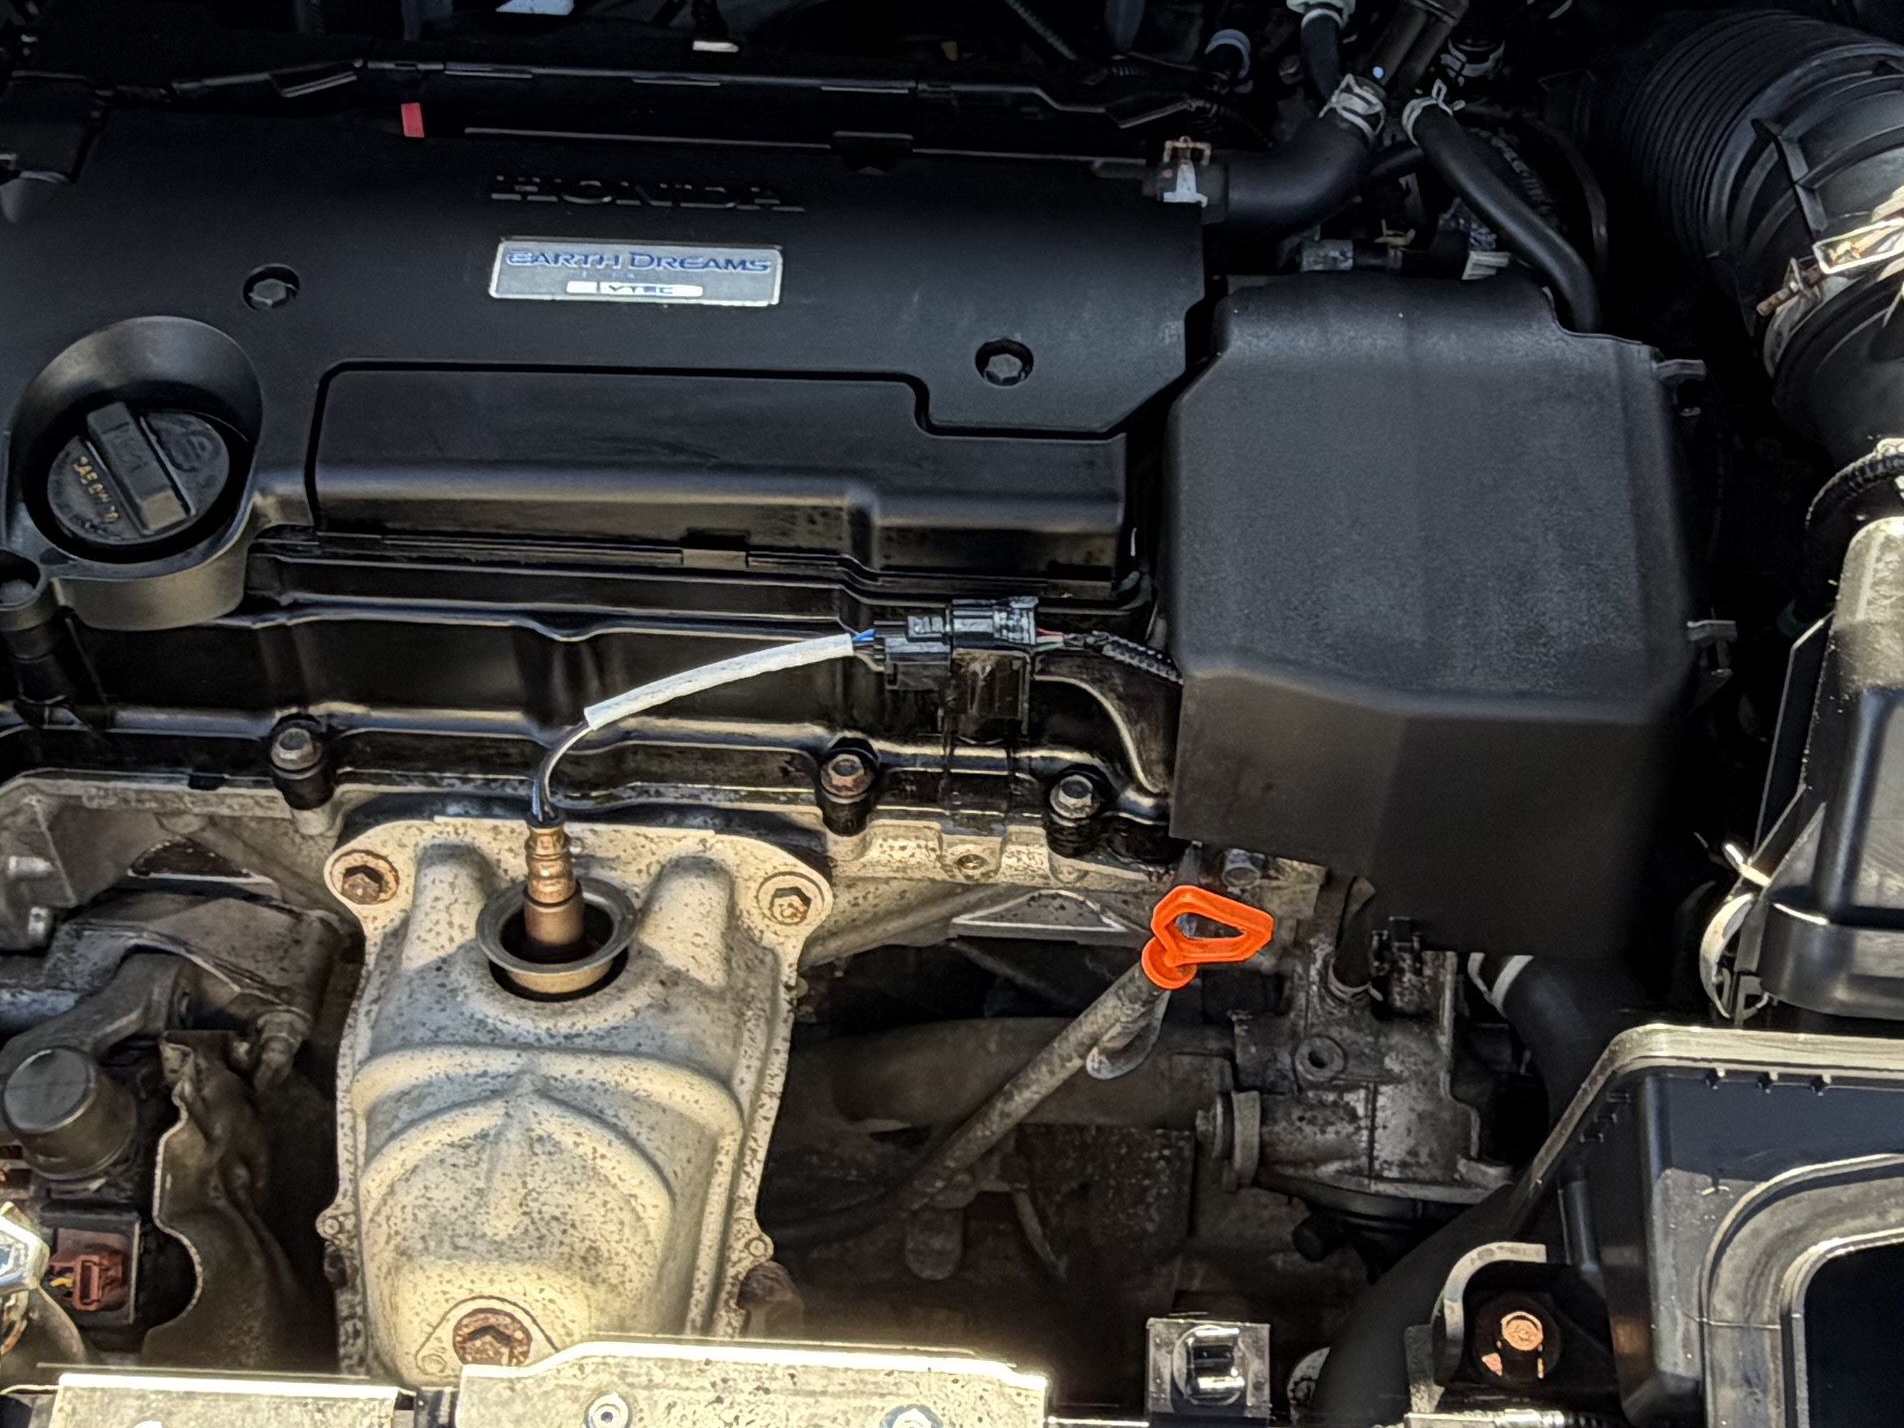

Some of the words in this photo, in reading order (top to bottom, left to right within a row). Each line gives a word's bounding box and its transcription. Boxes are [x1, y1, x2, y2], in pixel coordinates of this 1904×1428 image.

[491, 174, 806, 212] HONDA
[506, 250, 622, 271] EARTH
[628, 251, 772, 273] DREAMS
